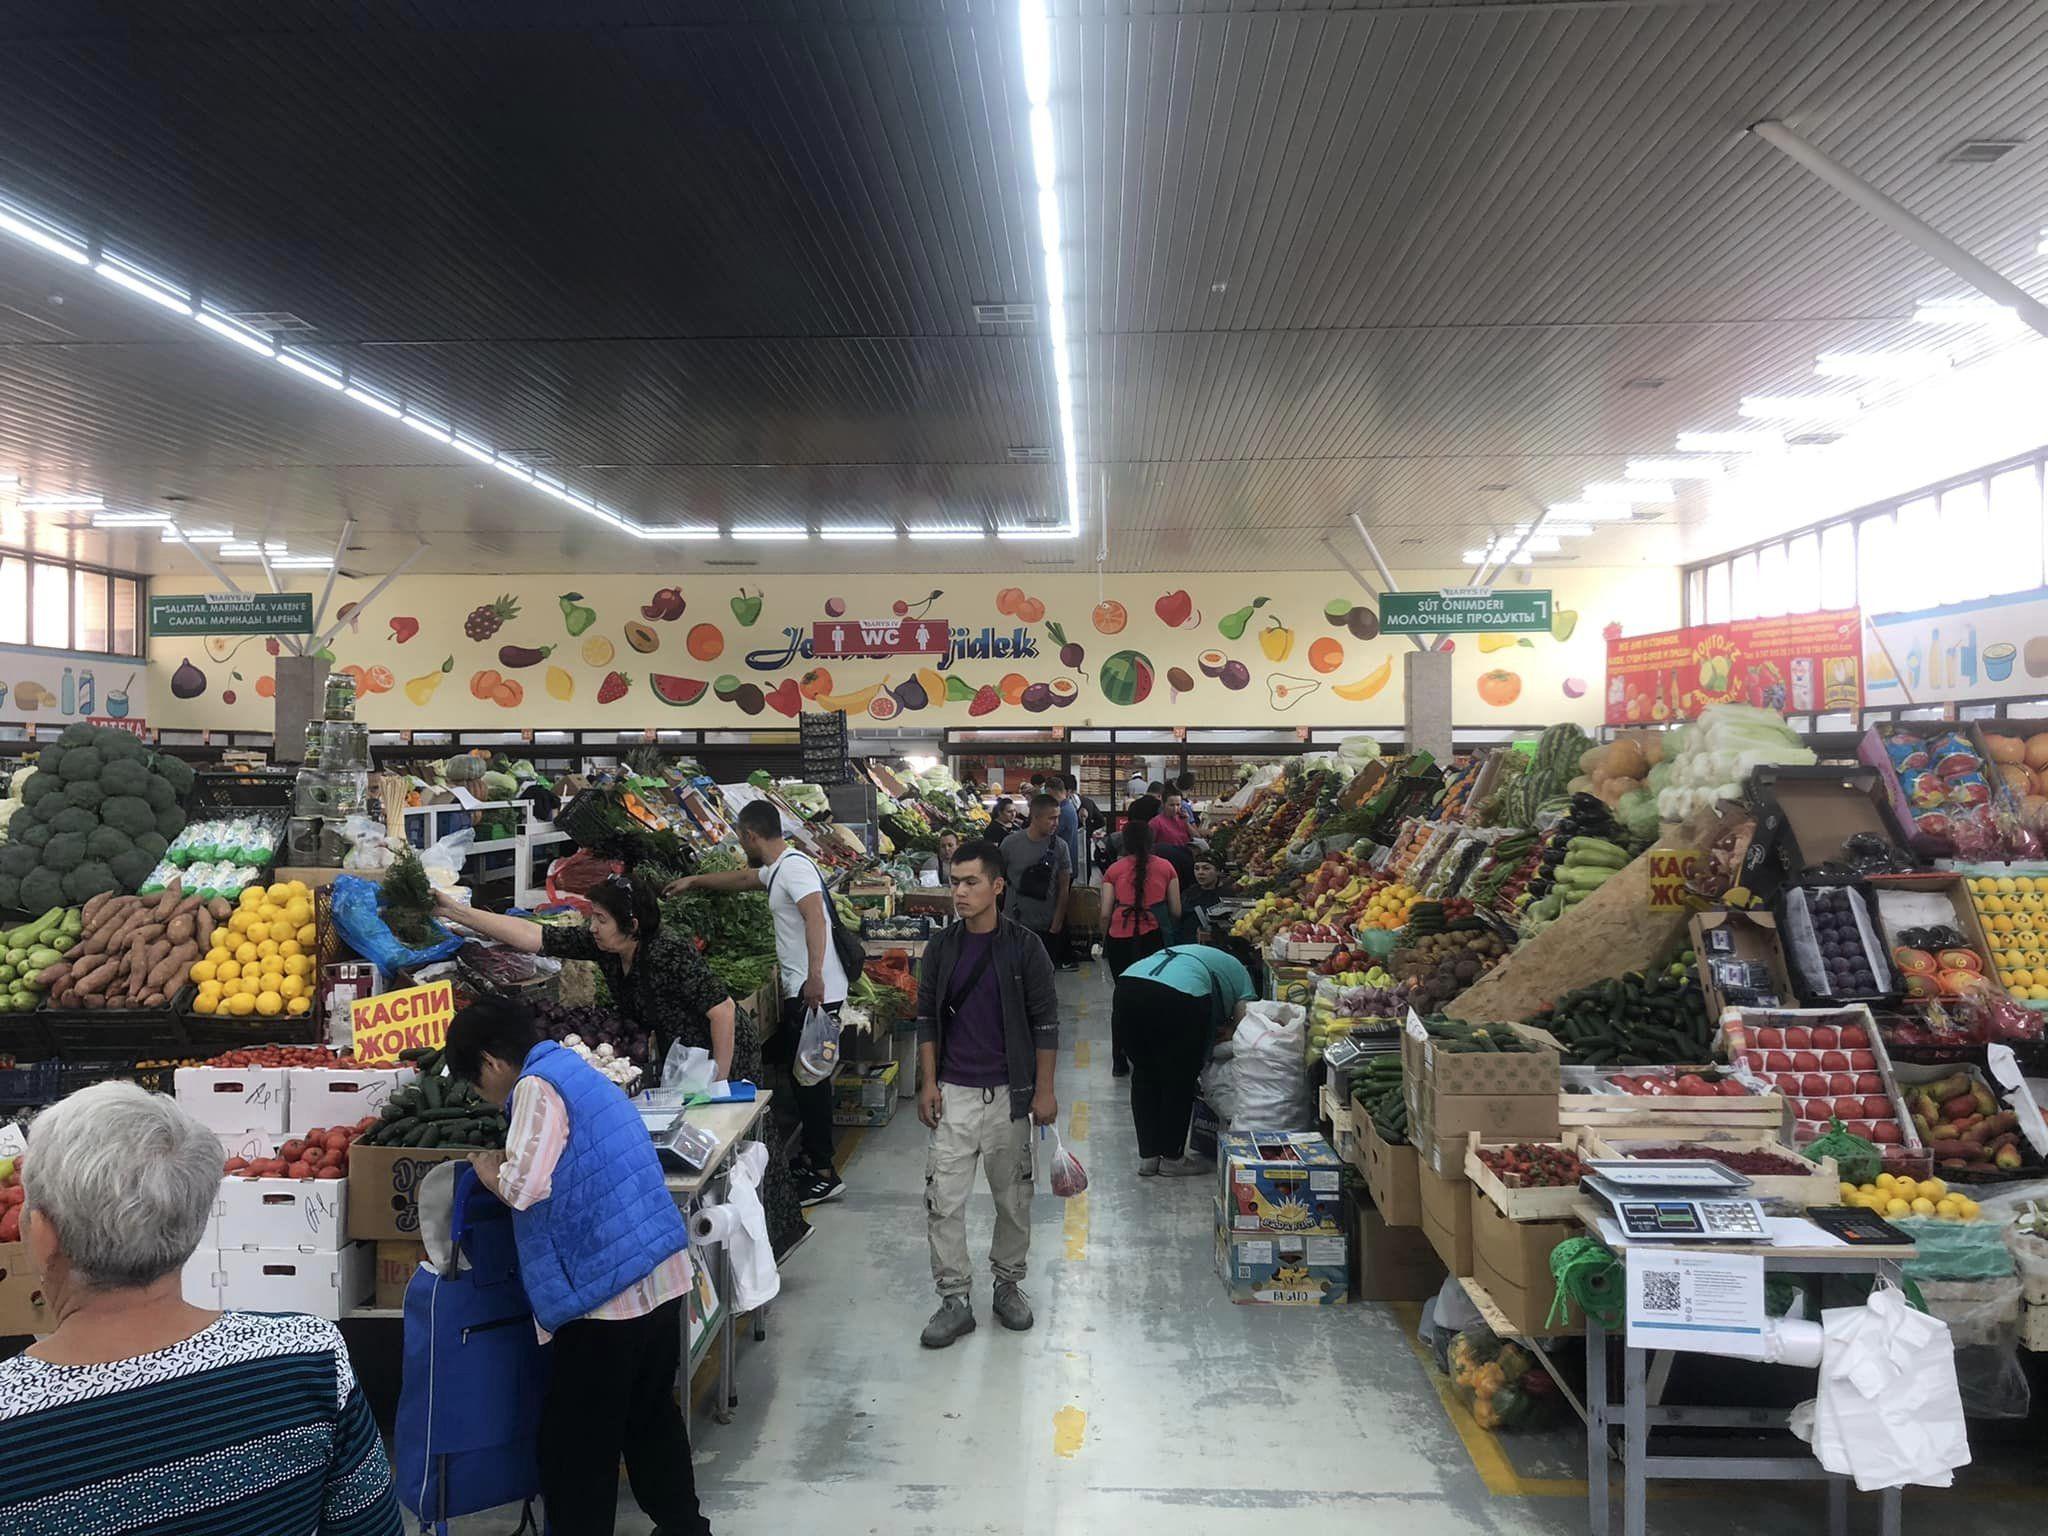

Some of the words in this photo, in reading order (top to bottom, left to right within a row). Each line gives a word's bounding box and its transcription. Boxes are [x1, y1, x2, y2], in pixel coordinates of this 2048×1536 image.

[266, 615, 303, 625] ВАРЕНЬЕ
[1387, 613, 1463, 625] МОЛОЧНЫЕ
[1467, 612, 1535, 625] ПРОДУКТЫ
[861, 630, 900, 646] WC
[354, 988, 450, 1032] КАСПИ
